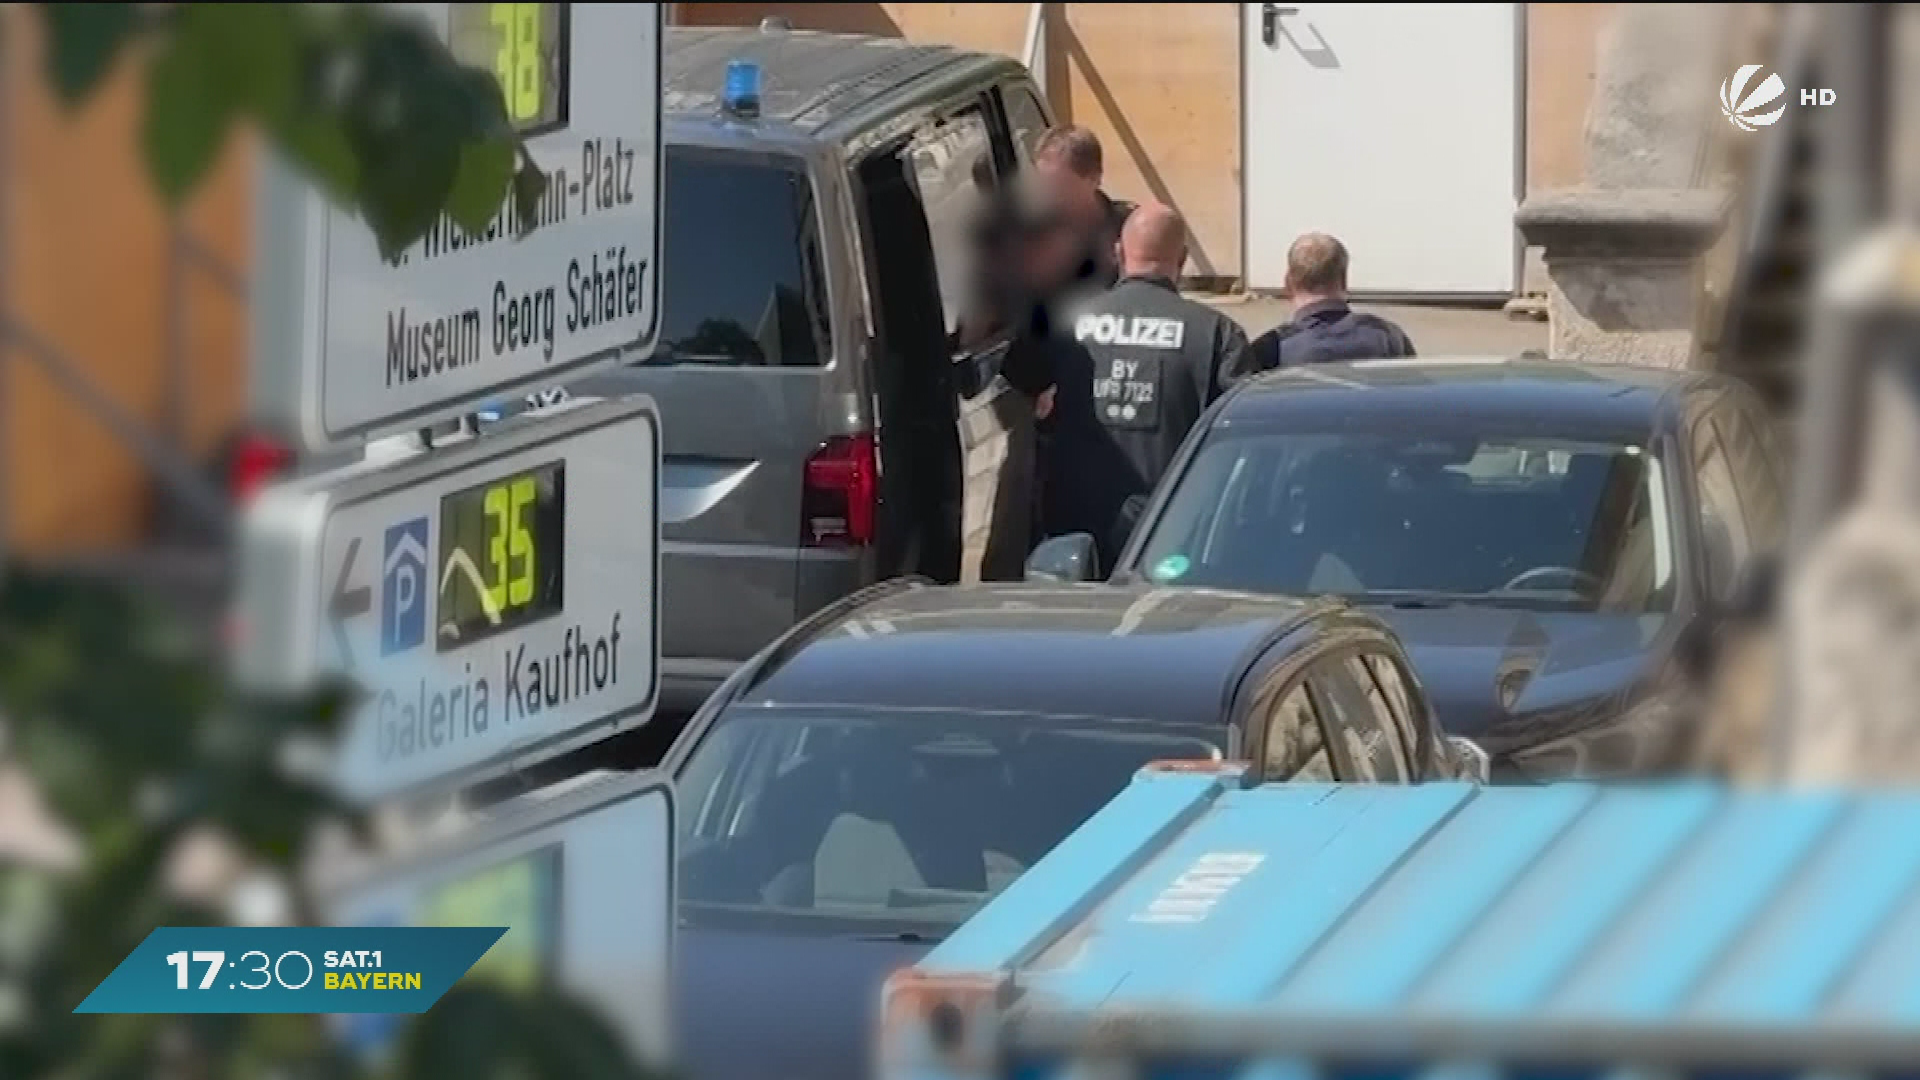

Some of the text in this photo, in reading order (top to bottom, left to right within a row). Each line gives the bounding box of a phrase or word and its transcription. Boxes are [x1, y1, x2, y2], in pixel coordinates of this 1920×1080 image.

[386, 246, 647, 389] Museum Georg Schäfer
[1075, 314, 1184, 348] POLIZEI
[1112, 359, 1138, 379] BY
[484, 476, 536, 612] 35
[395, 564, 416, 642] P
[377, 611, 620, 762] Galeria Kaufhof
